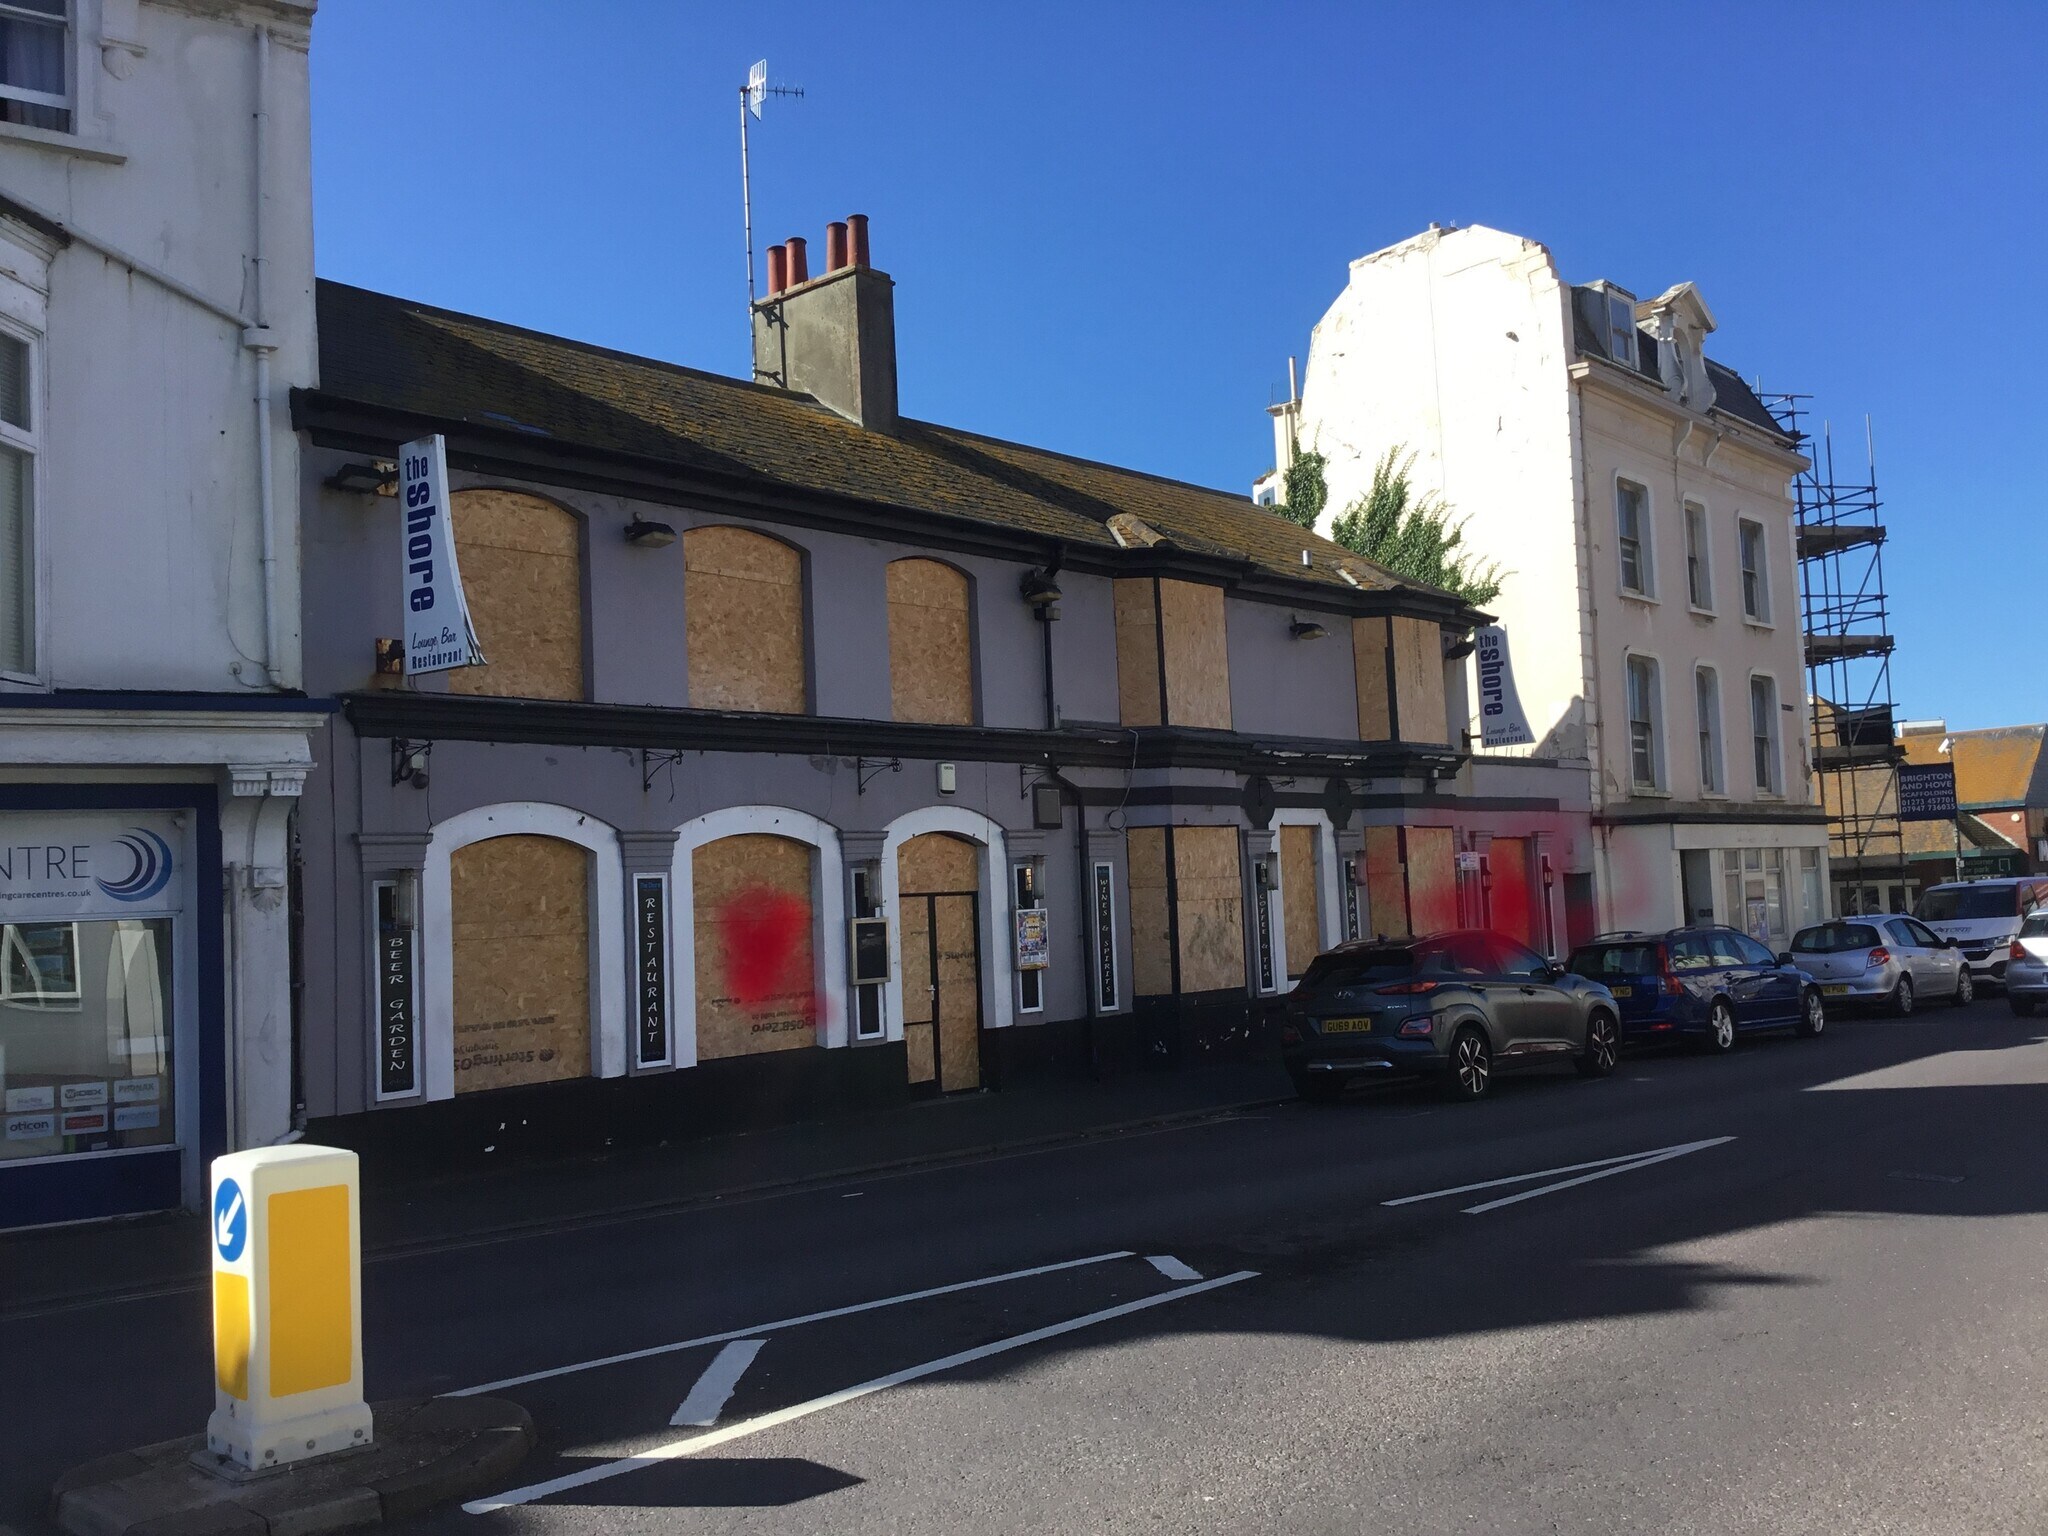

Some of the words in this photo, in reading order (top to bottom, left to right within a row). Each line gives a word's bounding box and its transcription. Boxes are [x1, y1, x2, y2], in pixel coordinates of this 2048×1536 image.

[405, 455, 429, 481] the
[406, 481, 436, 612] shore
[412, 632, 438, 652] Lounge
[441, 626, 457, 644] Bar
[1479, 635, 1498, 648] the
[412, 648, 462, 669] Restaurant
[1480, 648, 1504, 716] shore
[1900, 772, 1952, 782] BRIGHTON
[1925, 780, 1952, 789] HOVE
[1901, 789, 1953, 798] SCAFFOLDING
[1902, 798, 1925, 806] 01273
[1099, 879, 1108, 916] WINES
[388, 937, 404, 985] BEER
[645, 897, 658, 1043] RESTAURANT
[1103, 940, 1111, 993] SPIRITS
[388, 997, 406, 1072] GARDEN
[1327, 1021, 1349, 1032] GU69
[1352, 1020, 1368, 1030] AOV
[10, 1121, 49, 1132] oticon
